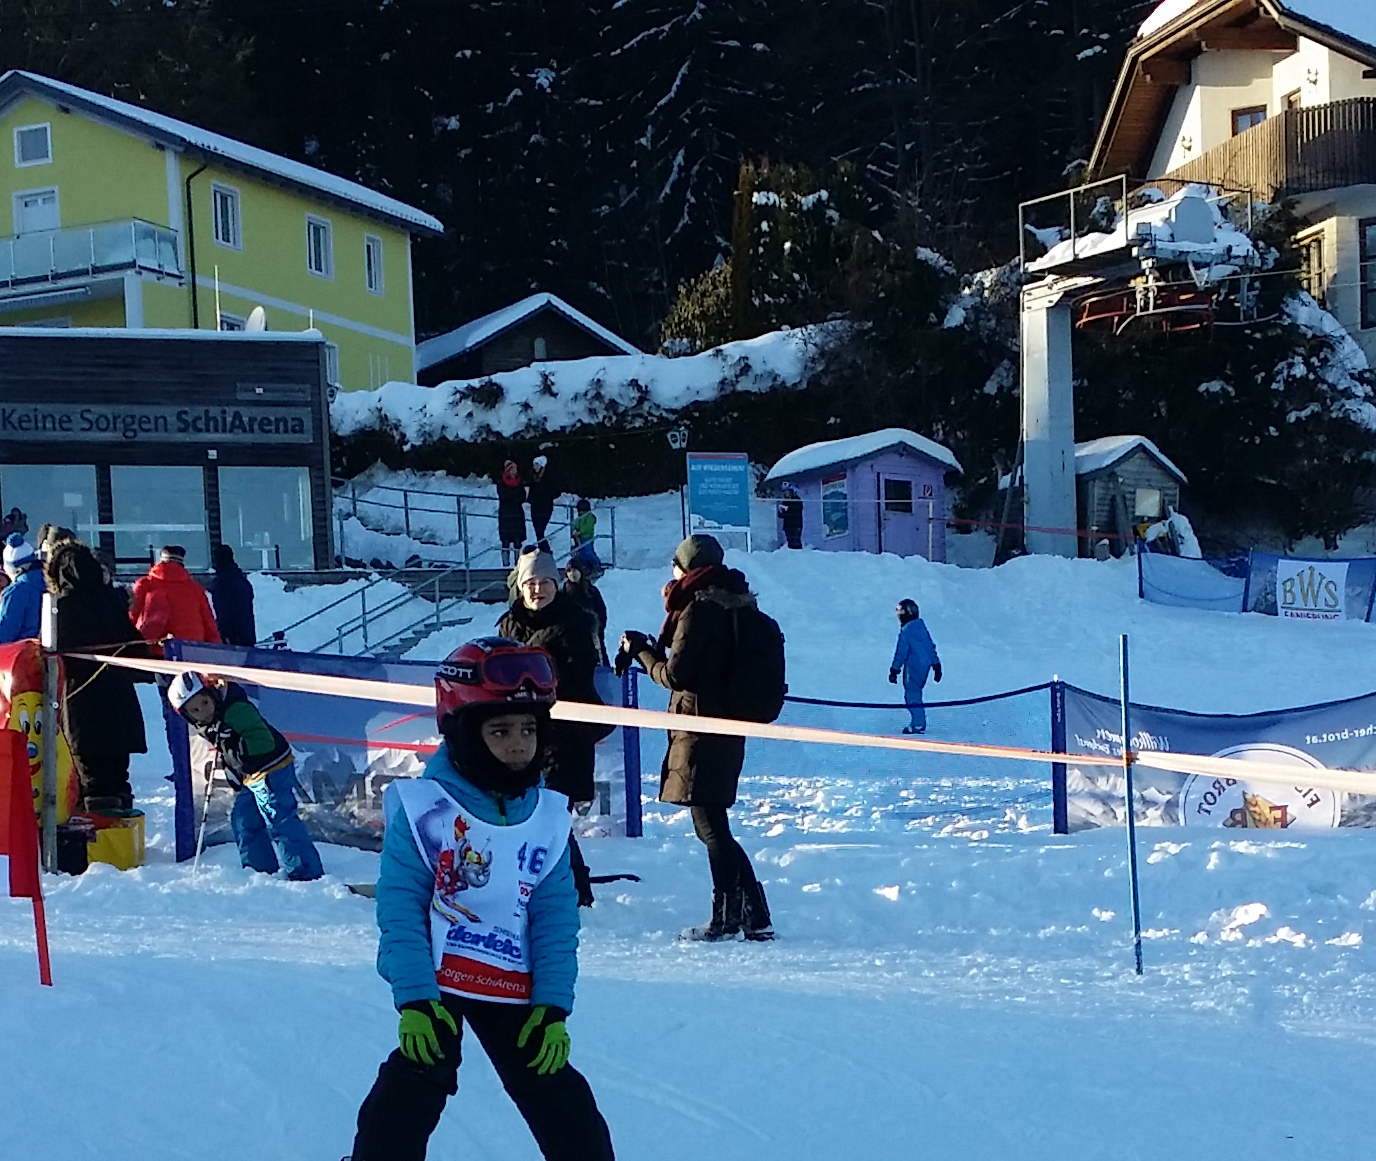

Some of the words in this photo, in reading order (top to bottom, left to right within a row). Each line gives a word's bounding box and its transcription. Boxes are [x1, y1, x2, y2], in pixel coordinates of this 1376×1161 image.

[1, 408, 73, 432] Keine
[79, 408, 169, 439] Sorgen
[176, 410, 306, 434] SchiArena
[1282, 566, 1339, 608] BWS
[438, 664, 473, 679] SCOTT
[475, 975, 526, 993] SchiArena
